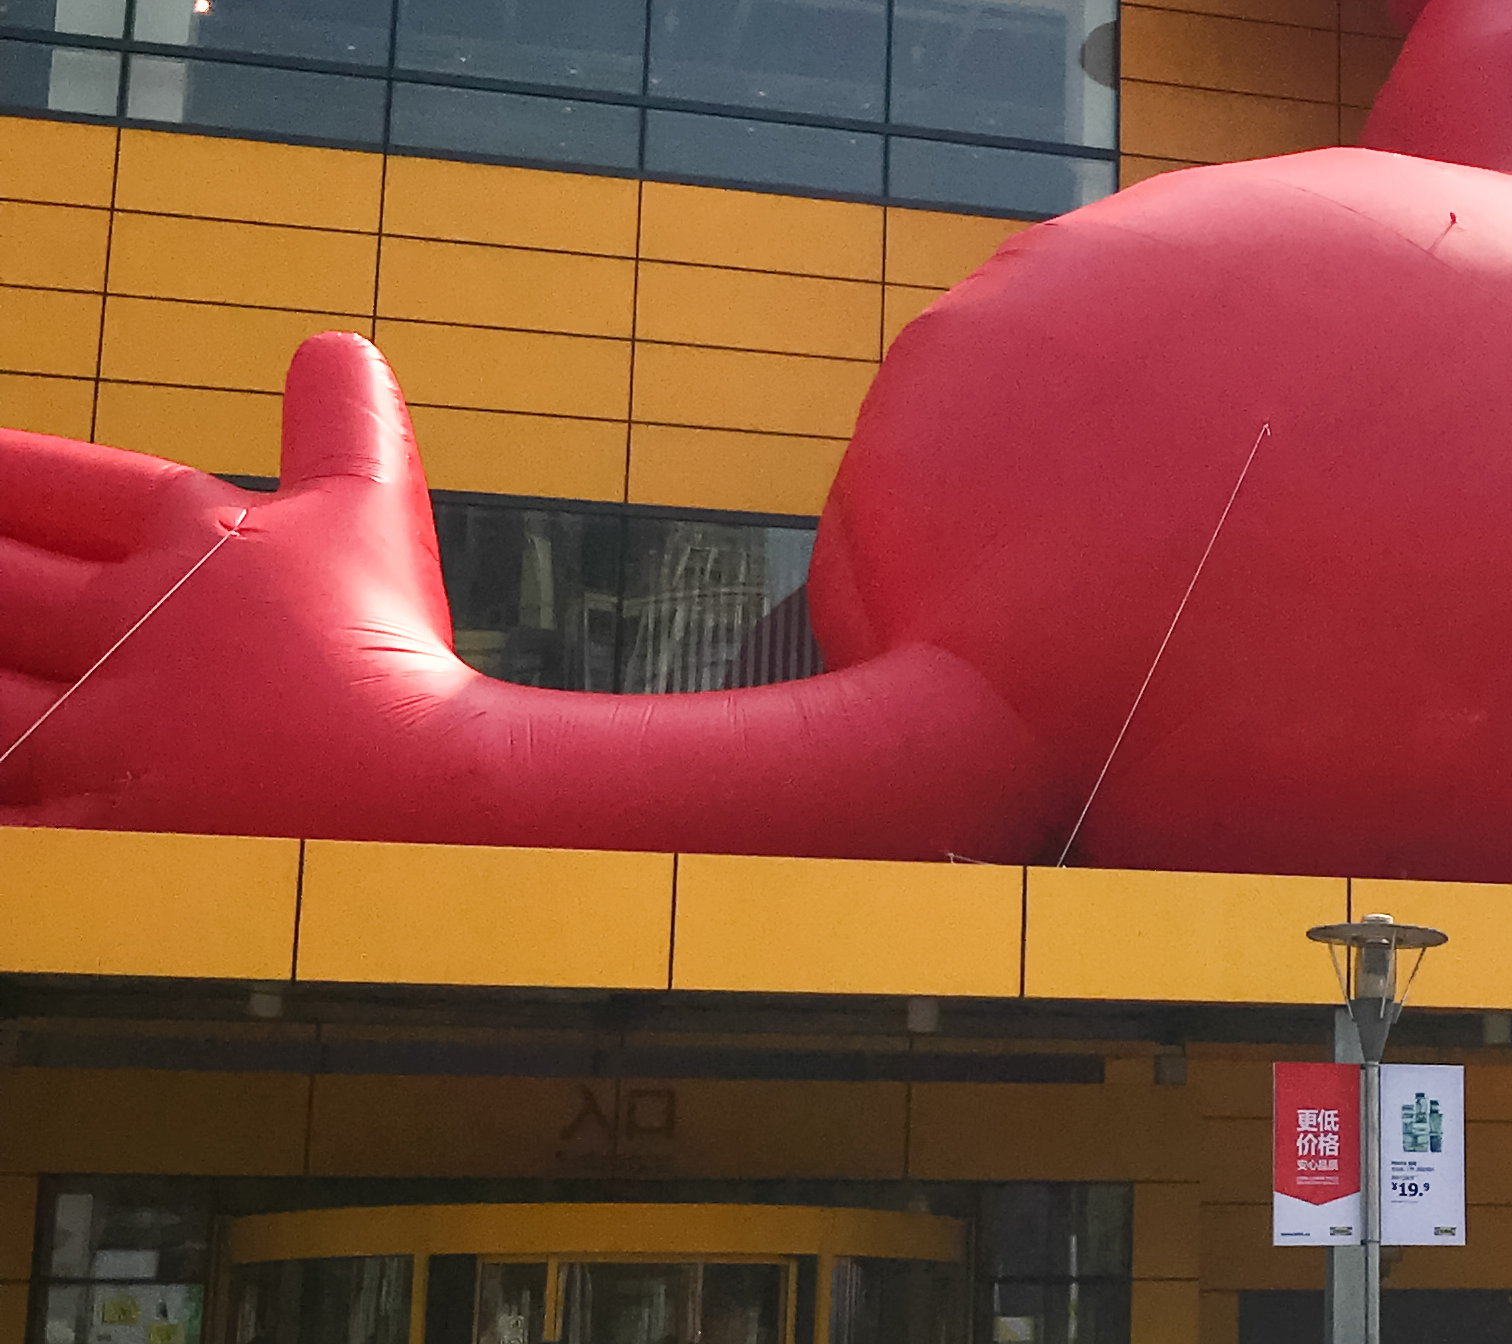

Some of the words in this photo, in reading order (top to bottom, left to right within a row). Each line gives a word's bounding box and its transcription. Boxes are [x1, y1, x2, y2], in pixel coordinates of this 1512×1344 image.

[560, 1083, 677, 1141] 入口
[1296, 1108, 1340, 1132] 更低
[1296, 1133, 1340, 1157] 价格
[1391, 1182, 1430, 1198] ¥19.9
